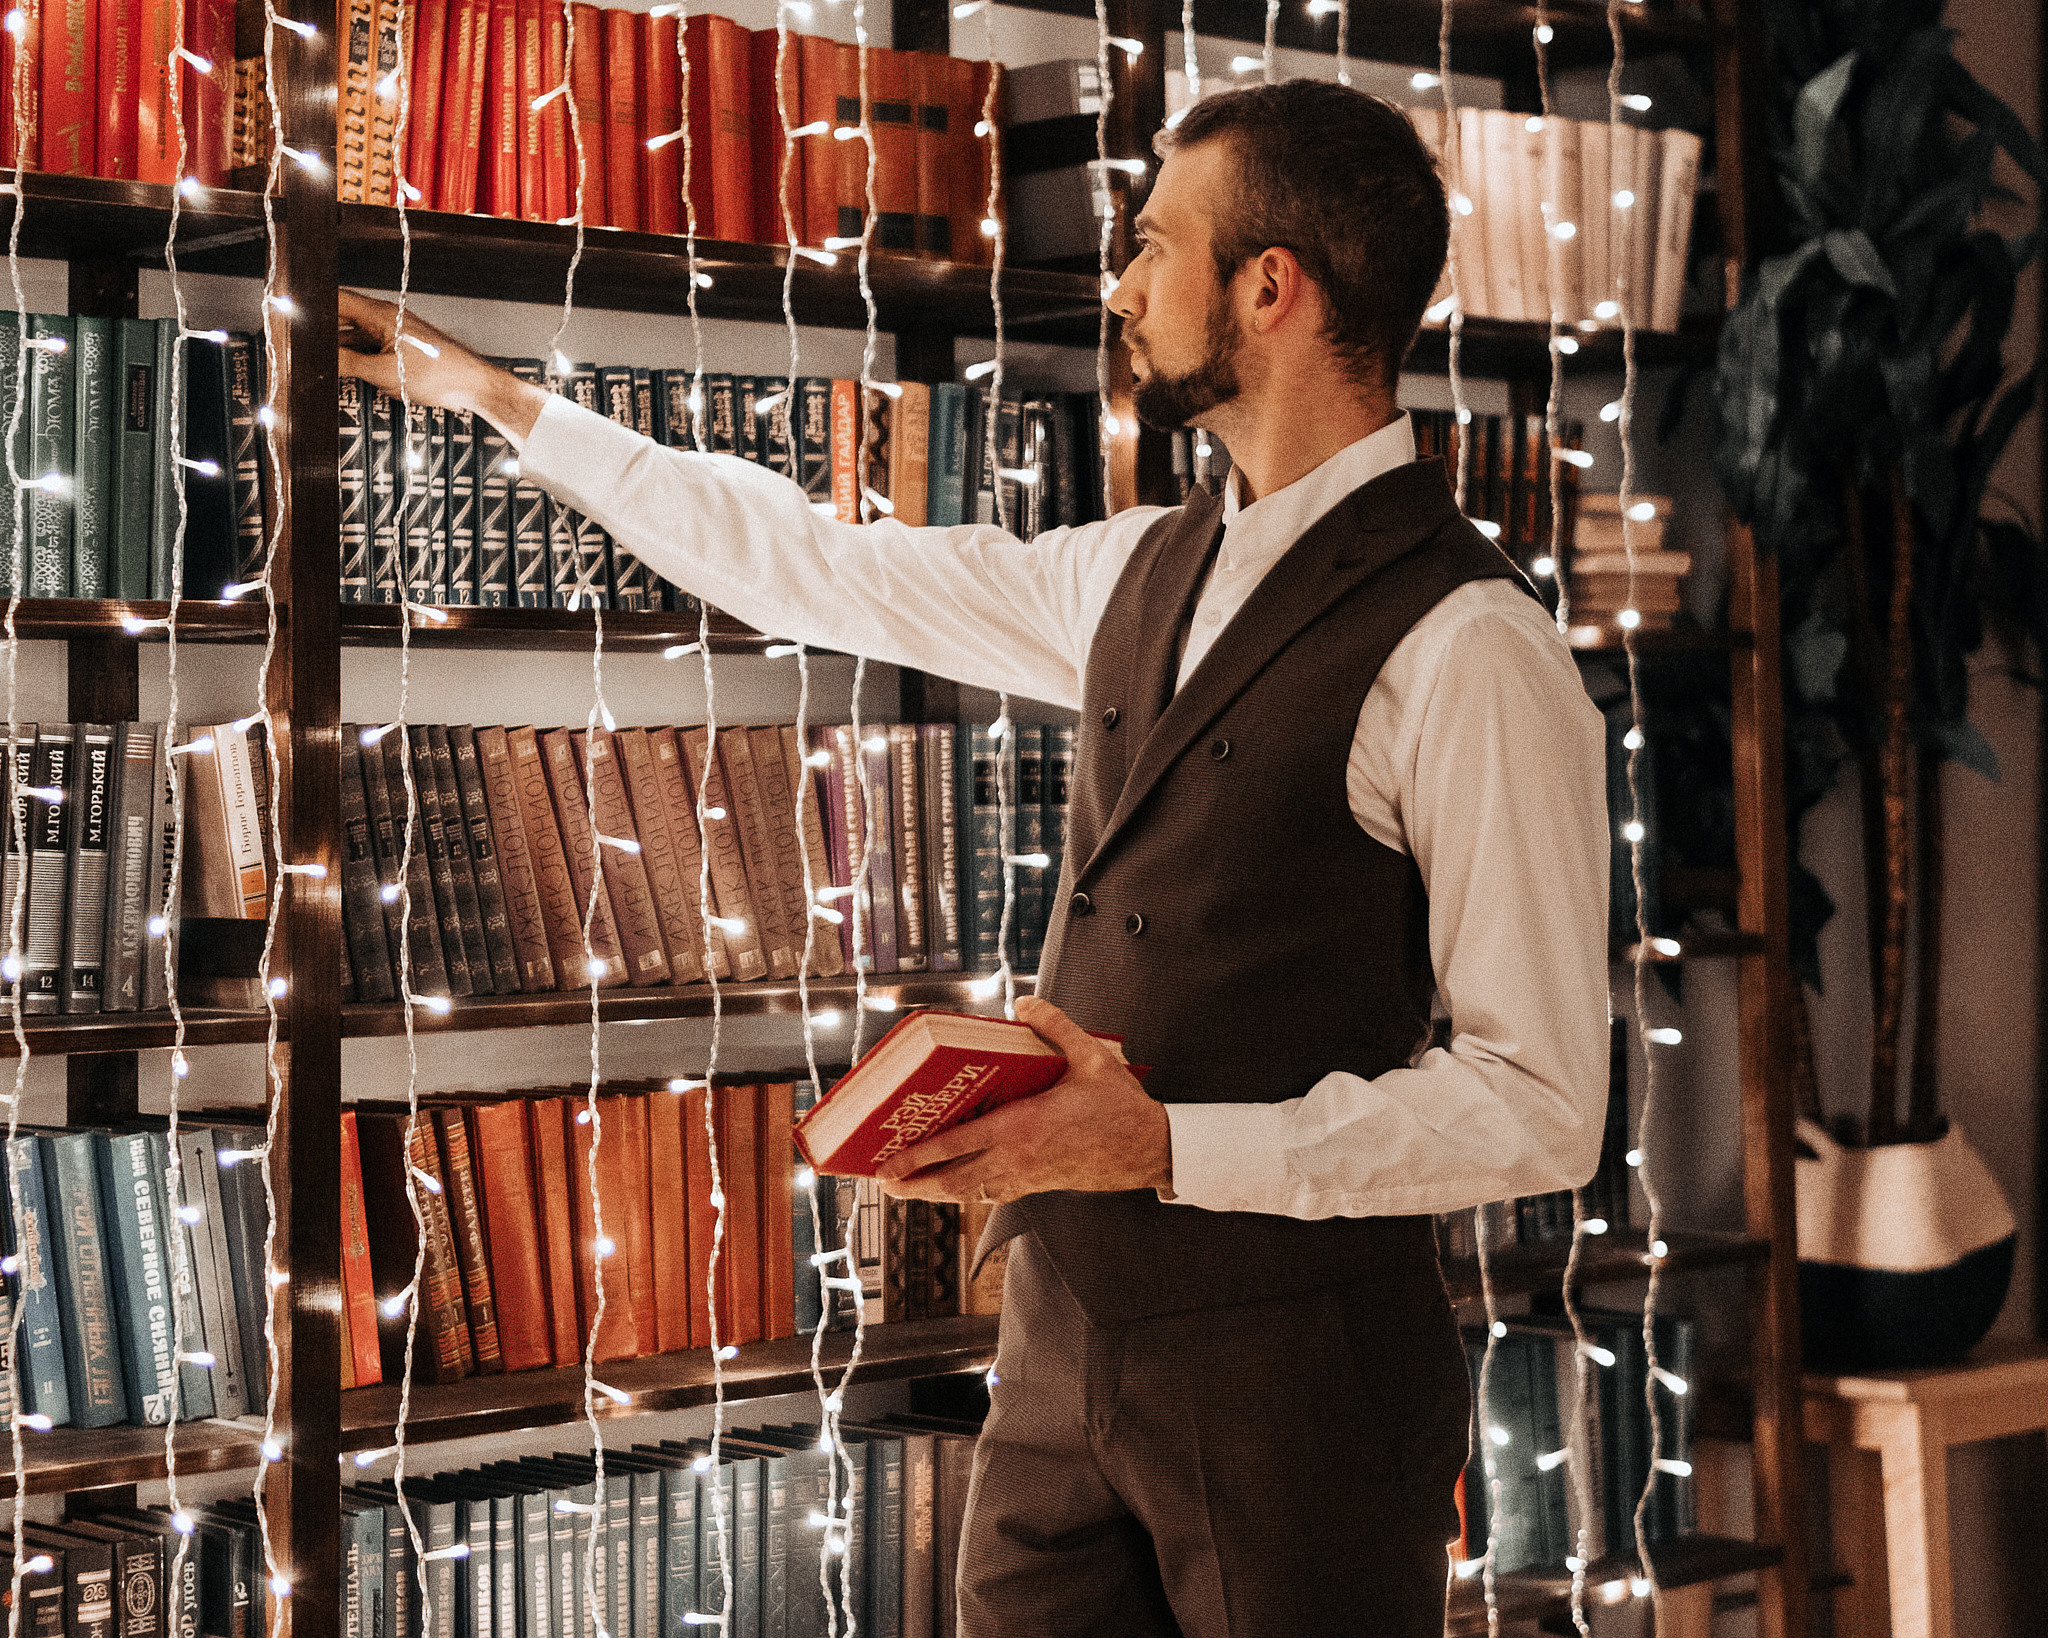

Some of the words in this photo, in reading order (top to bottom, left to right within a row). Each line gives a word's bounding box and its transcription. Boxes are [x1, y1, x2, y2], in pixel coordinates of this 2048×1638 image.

[833, 393, 848, 475] ГАЙДАР
[47, 749, 64, 843] М.ГОКИЙ
[89, 749, 107, 843] М.ГОРЬКИЙ
[490, 759, 530, 875] ЛОНДОН
[520, 758, 564, 873] ЛОНДОН
[594, 758, 638, 872] ЛНДОН
[940, 729, 954, 824] СТРУГАЦКИХ
[39, 975, 53, 988] 12
[82, 973, 94, 987] 14
[121, 975, 135, 997] 4
[459, 1167, 482, 1247] ФАДЕЕВ
[134, 1179, 162, 1302] СЕВЕРНОЕ
[149, 1304, 175, 1401] СИЯНИЕ
[347, 1542, 359, 1638] ТЕНДАЛЬ
[561, 1551, 573, 1638] ИШКОВ
